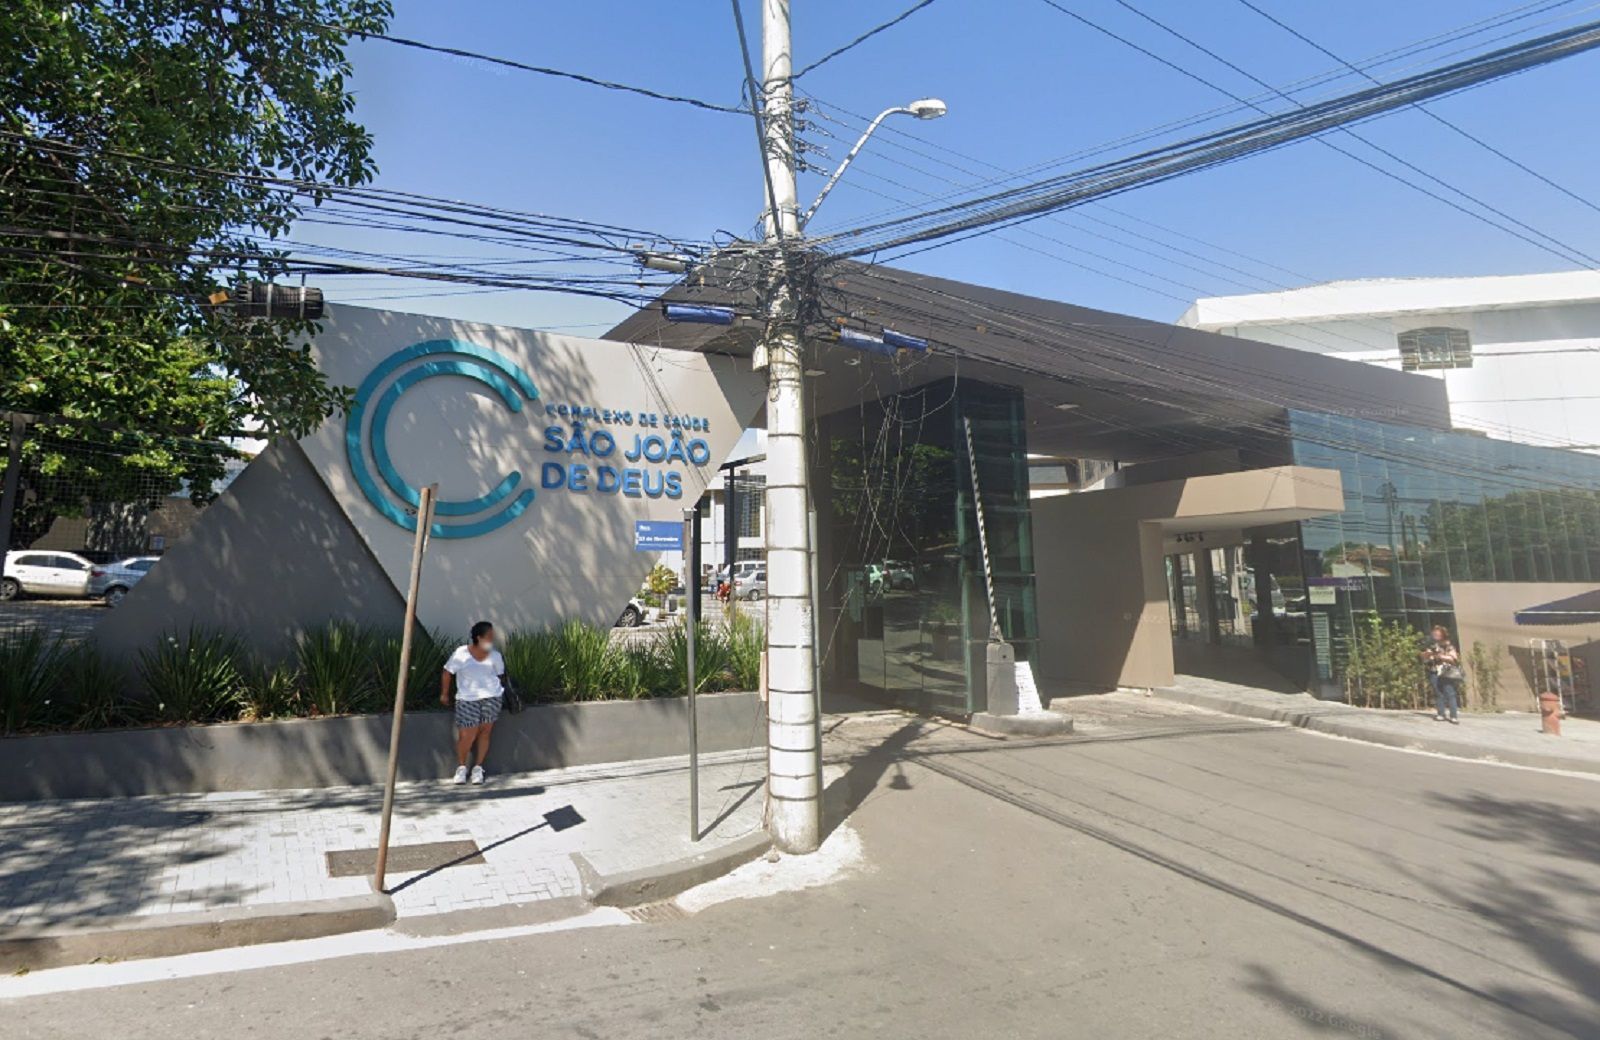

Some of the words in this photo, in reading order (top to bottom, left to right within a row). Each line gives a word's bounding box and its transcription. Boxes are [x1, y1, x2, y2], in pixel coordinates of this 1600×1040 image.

[545, 403, 633, 426] COMPLEXO
[638, 412, 658, 428] DE
[543, 420, 617, 459] SÃO
[624, 428, 711, 468] JOÃO
[541, 461, 590, 492] DE
[596, 465, 683, 499] DEUS
